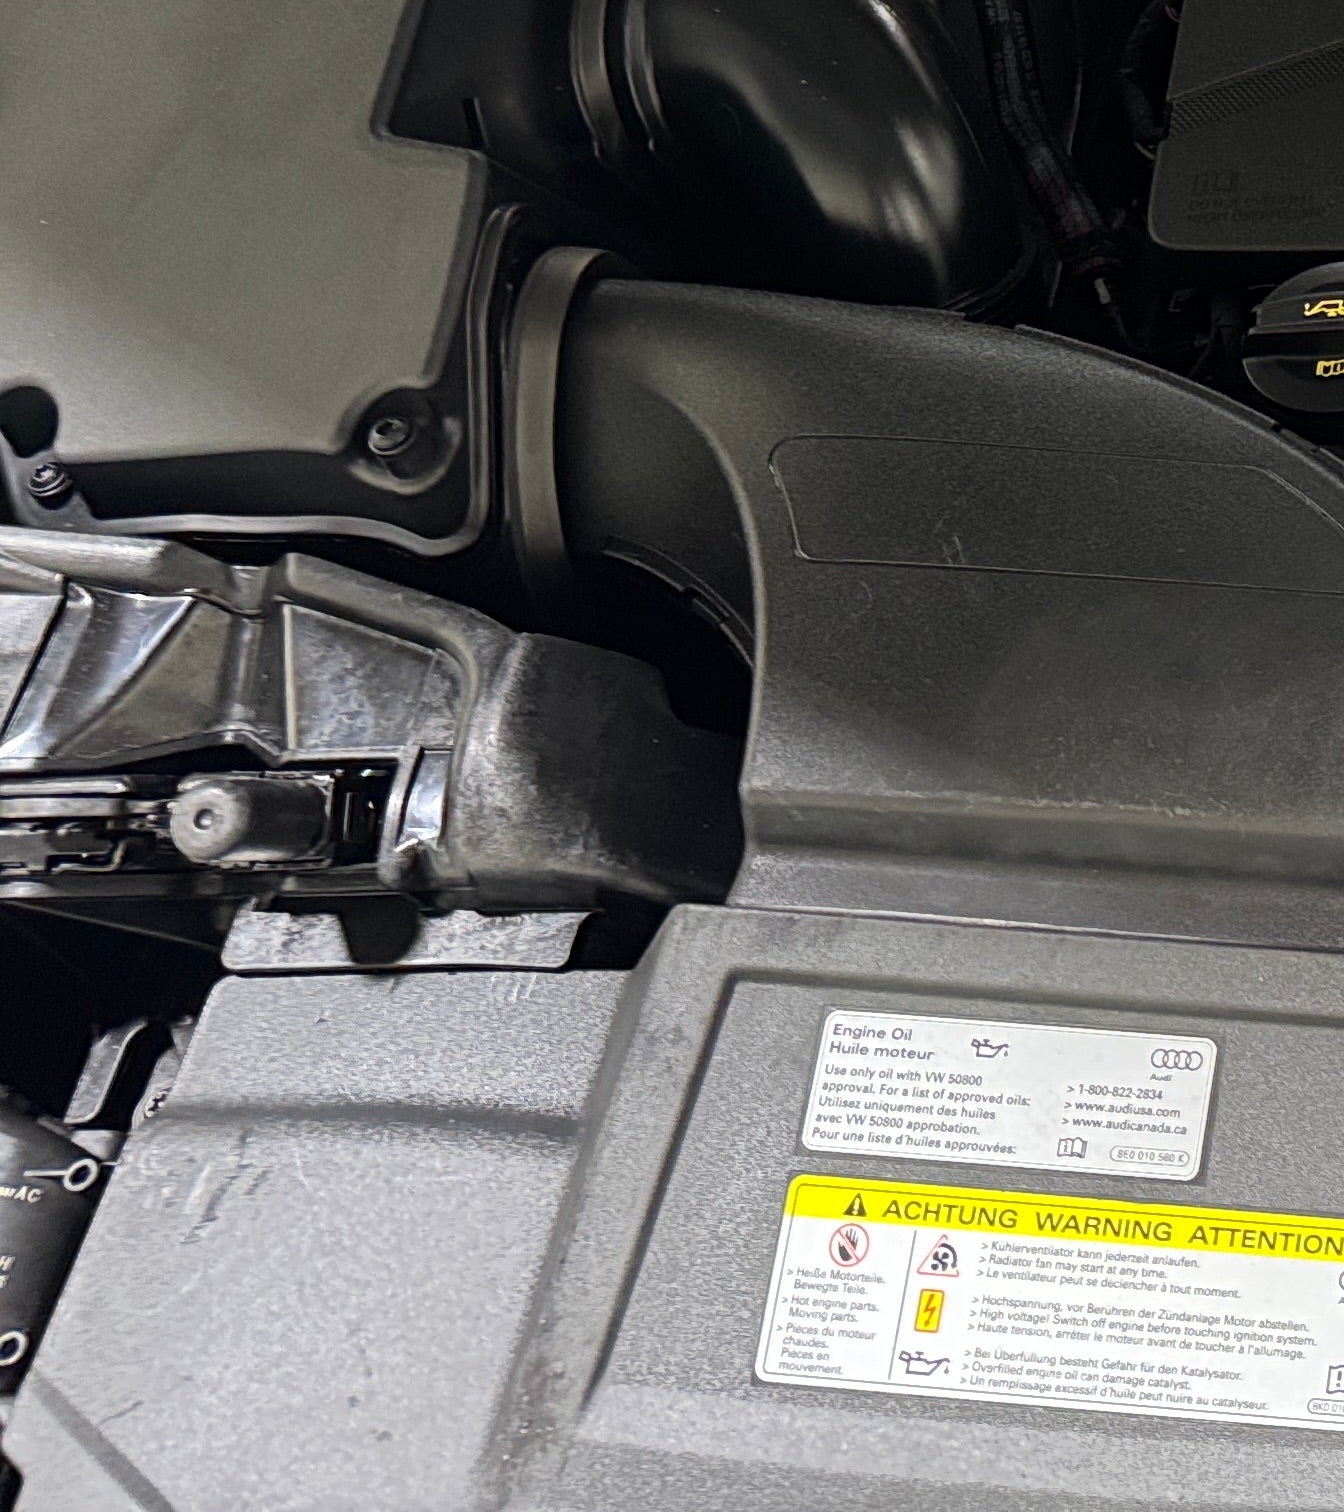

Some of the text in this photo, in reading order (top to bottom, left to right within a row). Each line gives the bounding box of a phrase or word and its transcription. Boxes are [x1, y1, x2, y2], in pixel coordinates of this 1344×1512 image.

[833, 1024, 913, 1041] Engine Oil
[830, 1041, 935, 1060] Huile moteur
[825, 1064, 982, 1086] Use only oil with VW 50800
[1150, 1073, 1172, 1081] Audi
[822, 1081, 1031, 1106] approval. For a list of approved oils:
[819, 1096, 996, 1120] Utilisez uniquement des huiles
[1075, 1102, 1180, 1118] www.audiusa.com
[812, 1127, 840, 1139] Pour
[843, 1132, 864, 1141] une
[868, 1133, 892, 1143] liste
[815, 1113, 842, 1123] avec
[846, 1114, 867, 1125] VW
[906, 1119, 980, 1135] approbation.
[1073, 1118, 1187, 1135] www.audicanada.ca
[882, 1200, 1344, 1255] ACHTUNG WARNING ATTENTION
[989, 1255, 1167, 1279] Radiator fan may start at any time.
[1078, 1249, 1102, 1259] kann
[1104, 1251, 1148, 1264] jederzeit
[1153, 1256, 1200, 1268] anlaufen.
[794, 1279, 838, 1293] Bewegte
[987, 1268, 999, 1278] Le
[1002, 1270, 1056, 1283] ventilateur
[1060, 1275, 1083, 1286] peut
[1086, 1278, 1098, 1286] se
[1161, 1282, 1167, 1292] à
[1170, 1284, 1191, 1294] tout
[1194, 1288, 1241, 1299] moment.
[789, 1307, 859, 1322] Moving parts.
[791, 1295, 879, 1312] Hot engine parts.
[980, 1308, 1004, 1320] High
[1053, 1315, 1088, 1326] Switch
[1091, 1318, 1106, 1327] off
[1109, 1321, 1144, 1332] engine
[1148, 1322, 1181, 1335] before
[1184, 1328, 1230, 1341] touching
[1234, 1331, 1273, 1343] ignition
[1277, 1334, 1318, 1347] system.
[1067, 1304, 1083, 1312] vor
[1138, 1308, 1155, 1318] der
[1224, 1315, 1255, 1327] Motor
[1259, 1318, 1309, 1332] abstellen.
[822, 1327, 835, 1336] du
[838, 1330, 876, 1340] moteur
[977, 1322, 1008, 1333] Haute
[1094, 1332, 1103, 1342] le
[1106, 1334, 1144, 1345] moteur
[1147, 1338, 1176, 1348] avant
[1179, 1339, 1193, 1349] de
[1195, 1343, 1234, 1354] toucher
[974, 1348, 990, 1359] Bei
[1060, 1355, 1098, 1368] besteht
[1102, 1358, 1137, 1372] Gefahr
[1158, 1365, 1177, 1375] den
[972, 1361, 1023, 1375] Overfilled
[1026, 1368, 1062, 1379] engine
[1065, 1370, 1078, 1380] oil
[1081, 1373, 1099, 1381] can
[1103, 1373, 1145, 1386] damage
[970, 1375, 985, 1386] Un
[988, 1378, 1052, 1392] remplissage
[1055, 1384, 1097, 1395] excessif
[1139, 1392, 1163, 1401] peut
[1165, 1393, 1193, 1405] nuire
[1196, 1397, 1209, 1405] au
